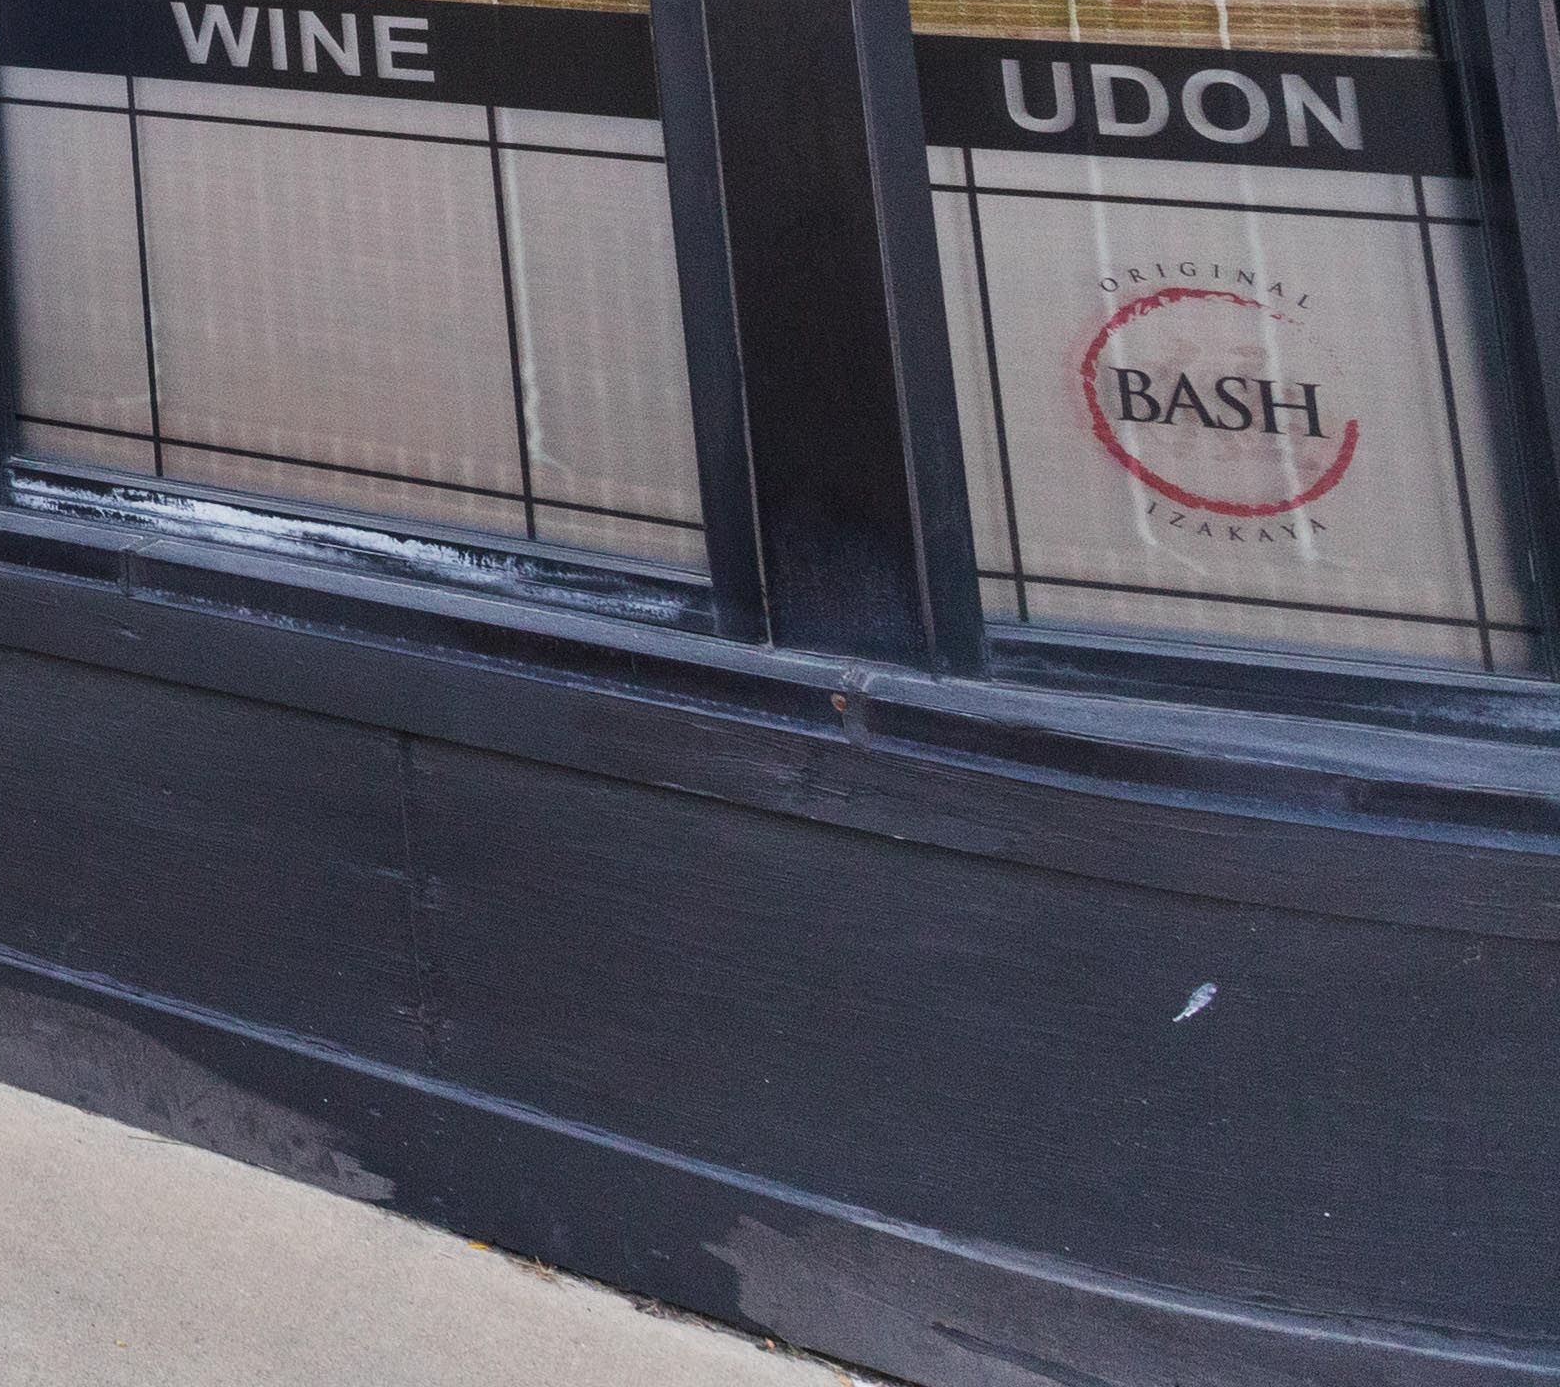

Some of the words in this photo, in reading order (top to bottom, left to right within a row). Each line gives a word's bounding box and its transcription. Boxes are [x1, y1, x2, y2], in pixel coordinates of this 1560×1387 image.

[169, 0, 436, 84] WINE
[999, 57, 1365, 152] UDON
[1098, 261, 1312, 310] ORIGINAL
[1108, 365, 1333, 440] BASH
[1146, 501, 1328, 543] IZAKAYA
